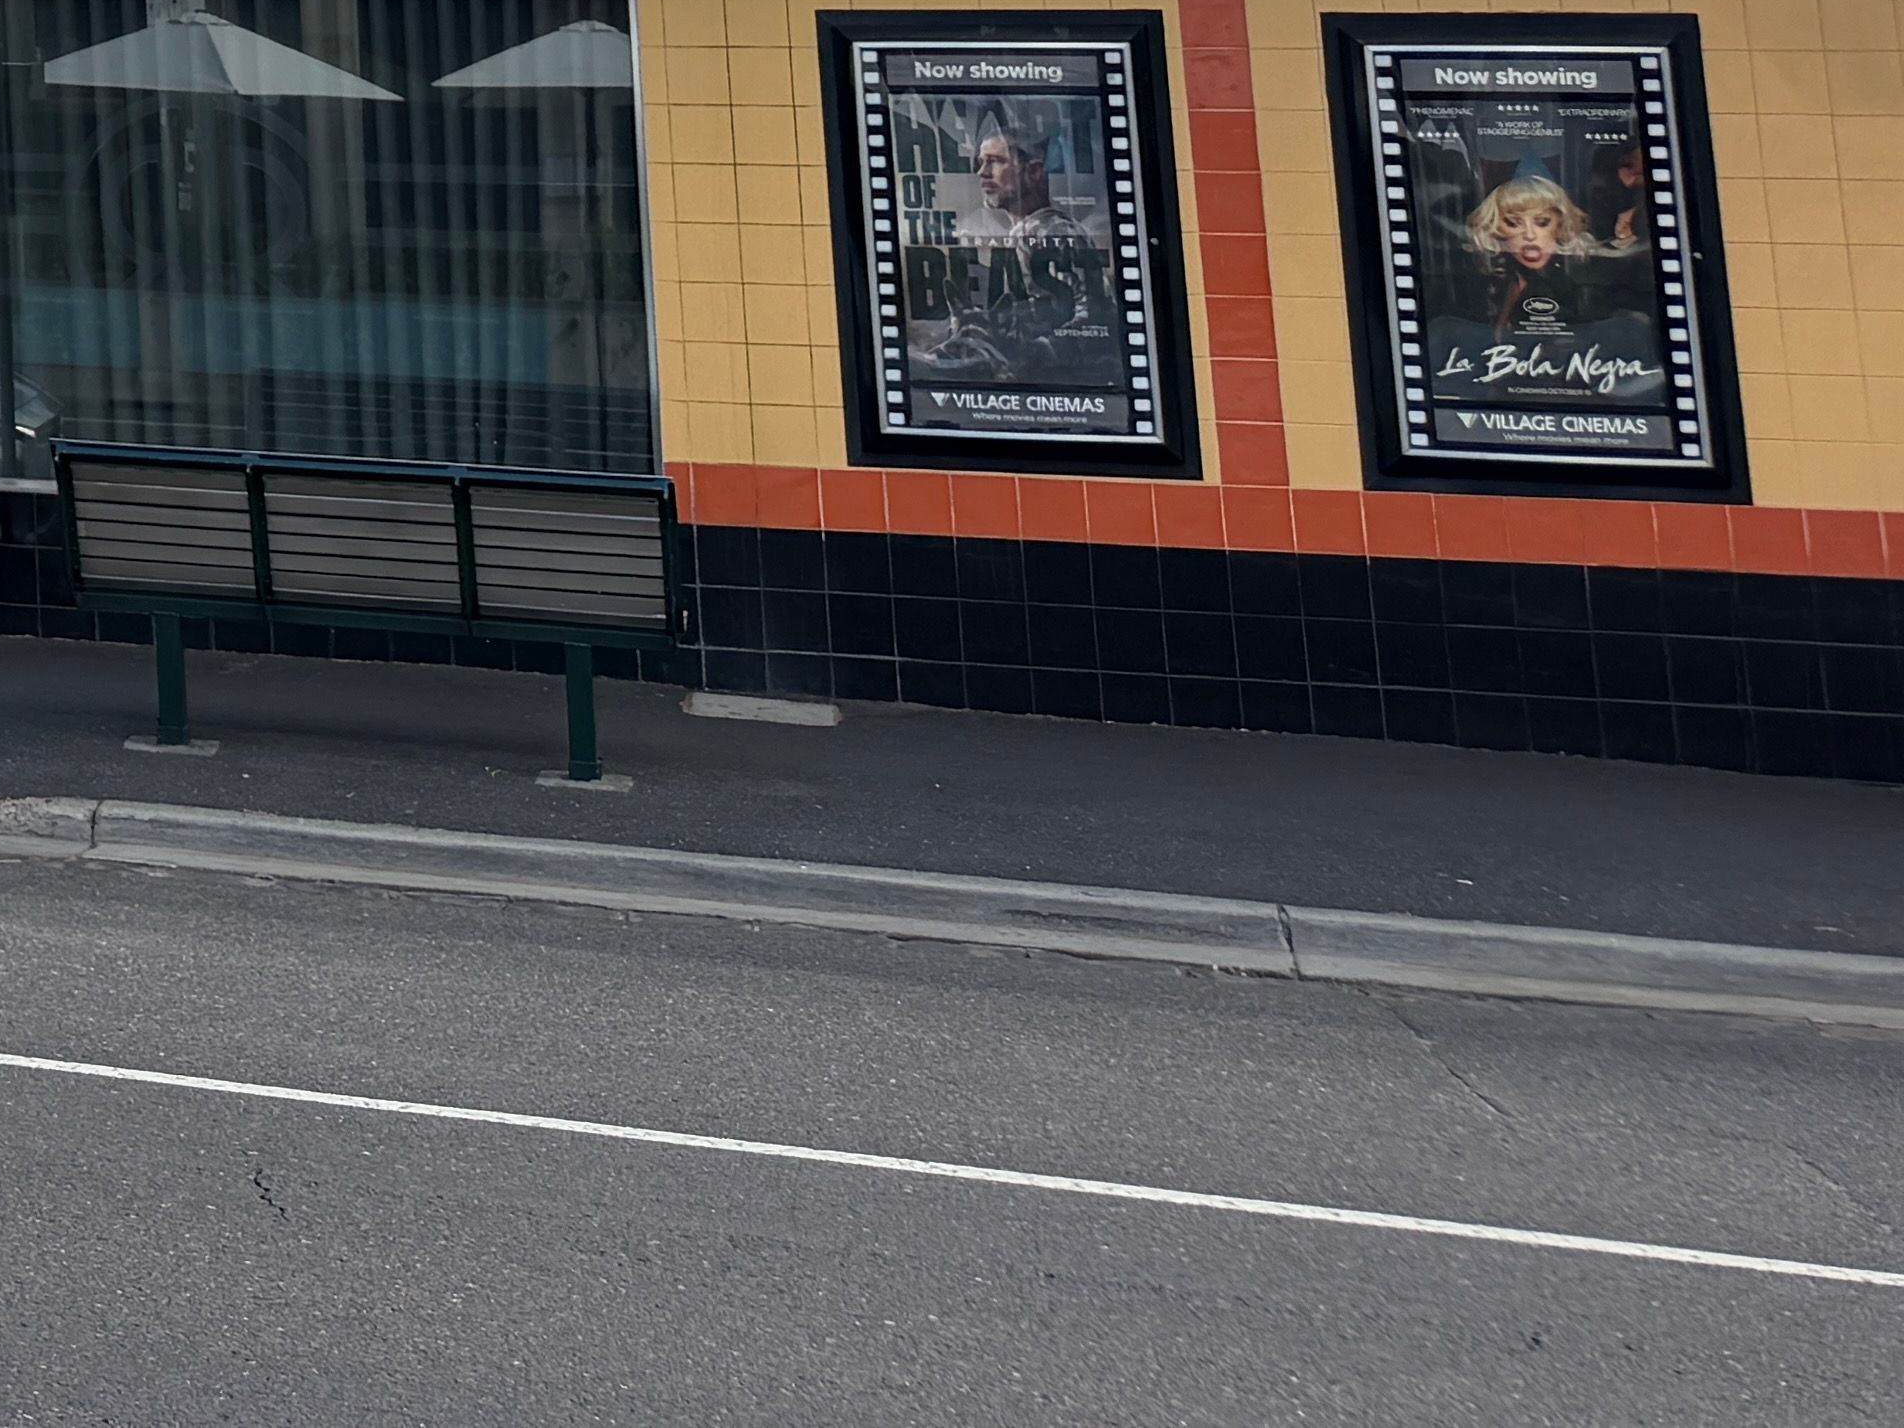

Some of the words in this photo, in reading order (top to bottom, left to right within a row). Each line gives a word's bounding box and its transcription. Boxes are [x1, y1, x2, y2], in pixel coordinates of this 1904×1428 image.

[914, 61, 965, 79] Now
[969, 61, 1063, 83] showing
[1434, 67, 1489, 85] Now
[1495, 67, 1597, 89] showing
[902, 173, 936, 210] OF
[903, 210, 959, 246] THE
[1028, 236, 1076, 249] PITT
[904, 246, 1112, 324] BEAST
[1436, 346, 1475, 377] La
[1472, 342, 1563, 383] Bola
[1565, 343, 1663, 394] Negra
[952, 393, 1021, 410] VILLAGE
[1025, 396, 1105, 413] CINEMAS
[1481, 413, 1556, 432] VILLAGE
[1561, 416, 1649, 435] CINEMAS
